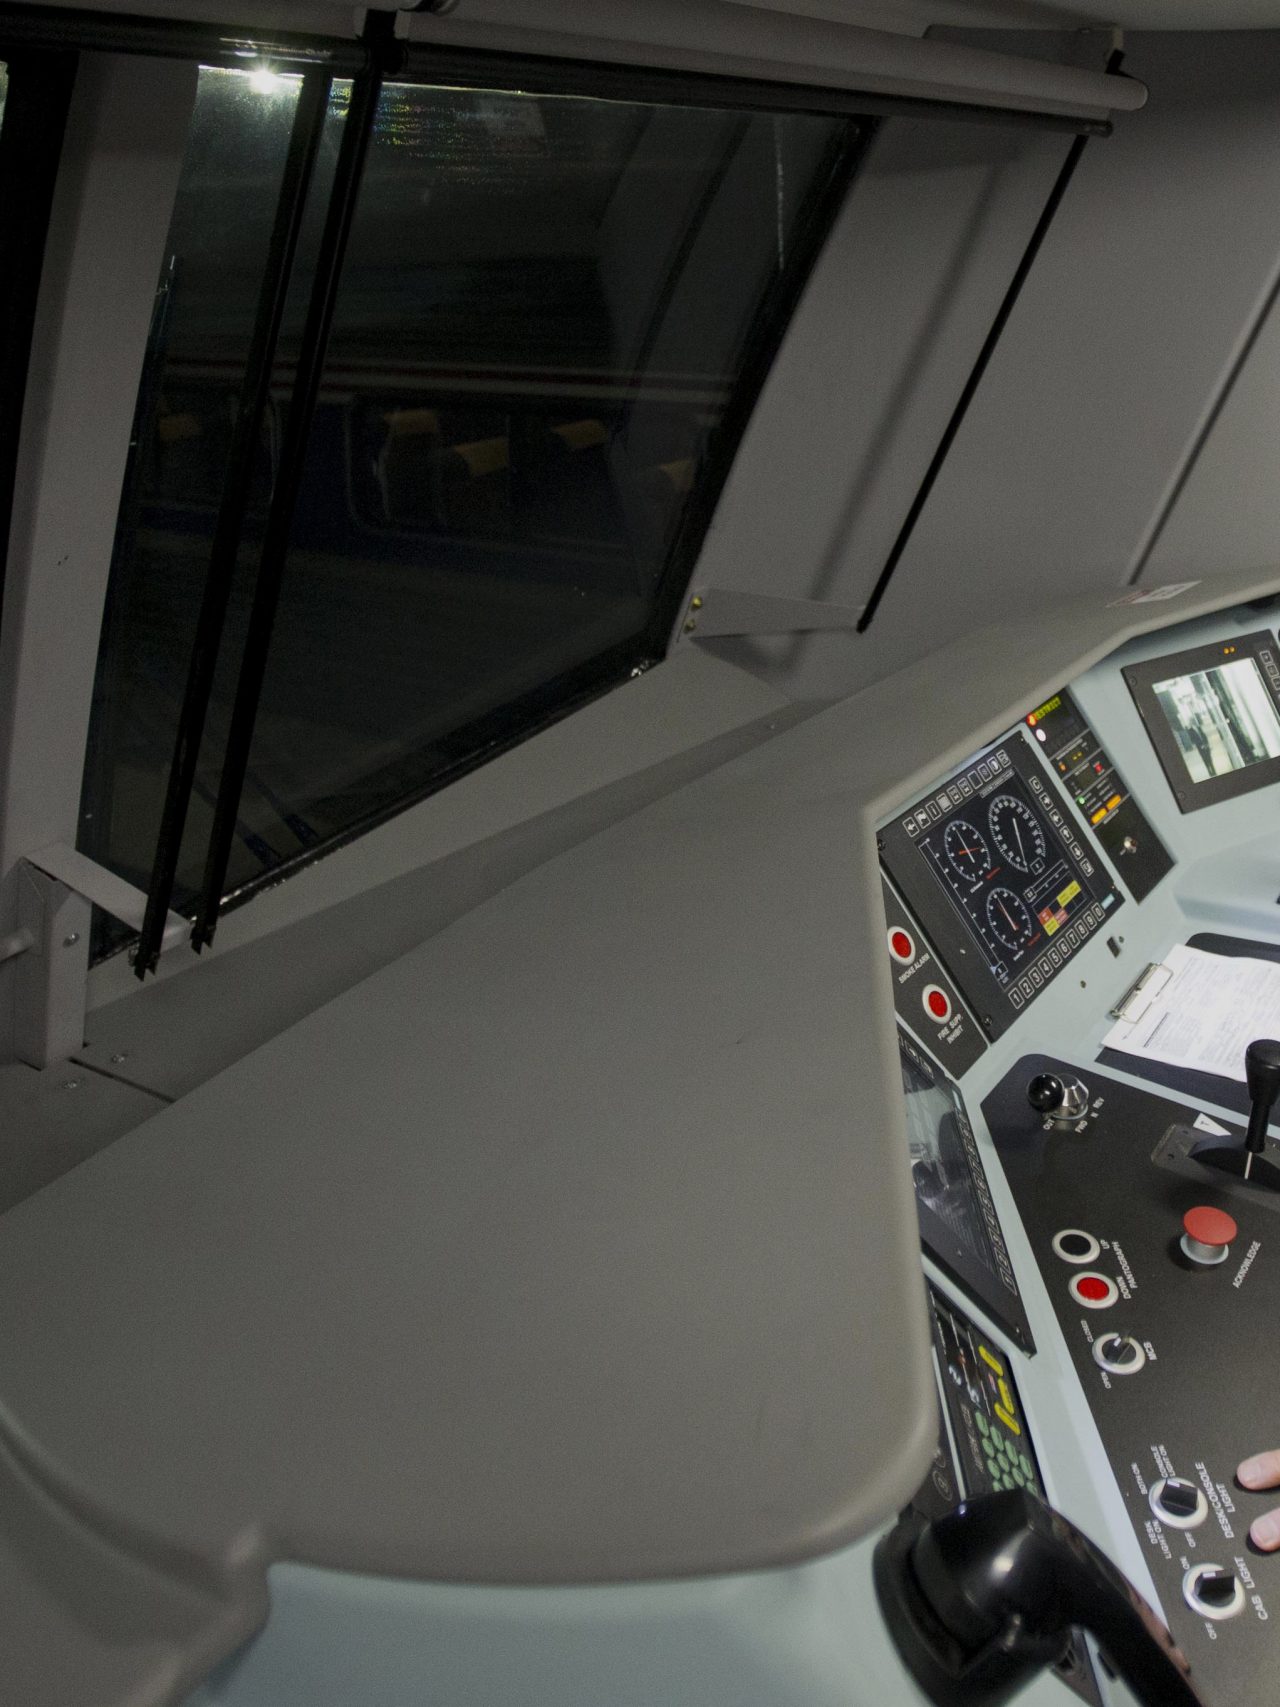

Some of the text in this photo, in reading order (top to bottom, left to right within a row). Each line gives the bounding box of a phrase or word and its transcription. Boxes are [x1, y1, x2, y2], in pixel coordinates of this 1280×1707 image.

[898, 952, 930, 984] SMOKE ALARM
[937, 1026, 950, 1040] FIRE
[1100, 1238, 1110, 1250] UP
[1112, 1241, 1138, 1289] PANTOGRAPH
[1232, 1240, 1262, 1289] ACKNOWLEDGE
[1115, 1275, 1131, 1300] DOWN
[1143, 1340, 1157, 1361] MCB
[1151, 1445, 1168, 1478] CONSOLE
[1158, 1444, 1176, 1477] LIGHT ON
[1131, 1462, 1148, 1495] BOTH ON
[1195, 1461, 1235, 1539] DESK/CONSOLE
[1215, 1483, 1236, 1513] LIGHT
[1144, 1520, 1158, 1545] DESK
[1152, 1519, 1172, 1560] LIGHT ON
[1184, 1531, 1196, 1548] OFF
[1180, 1555, 1190, 1570] ON
[1234, 1556, 1269, 1621] CAB LIGHT
[1205, 1621, 1217, 1640] OFF
